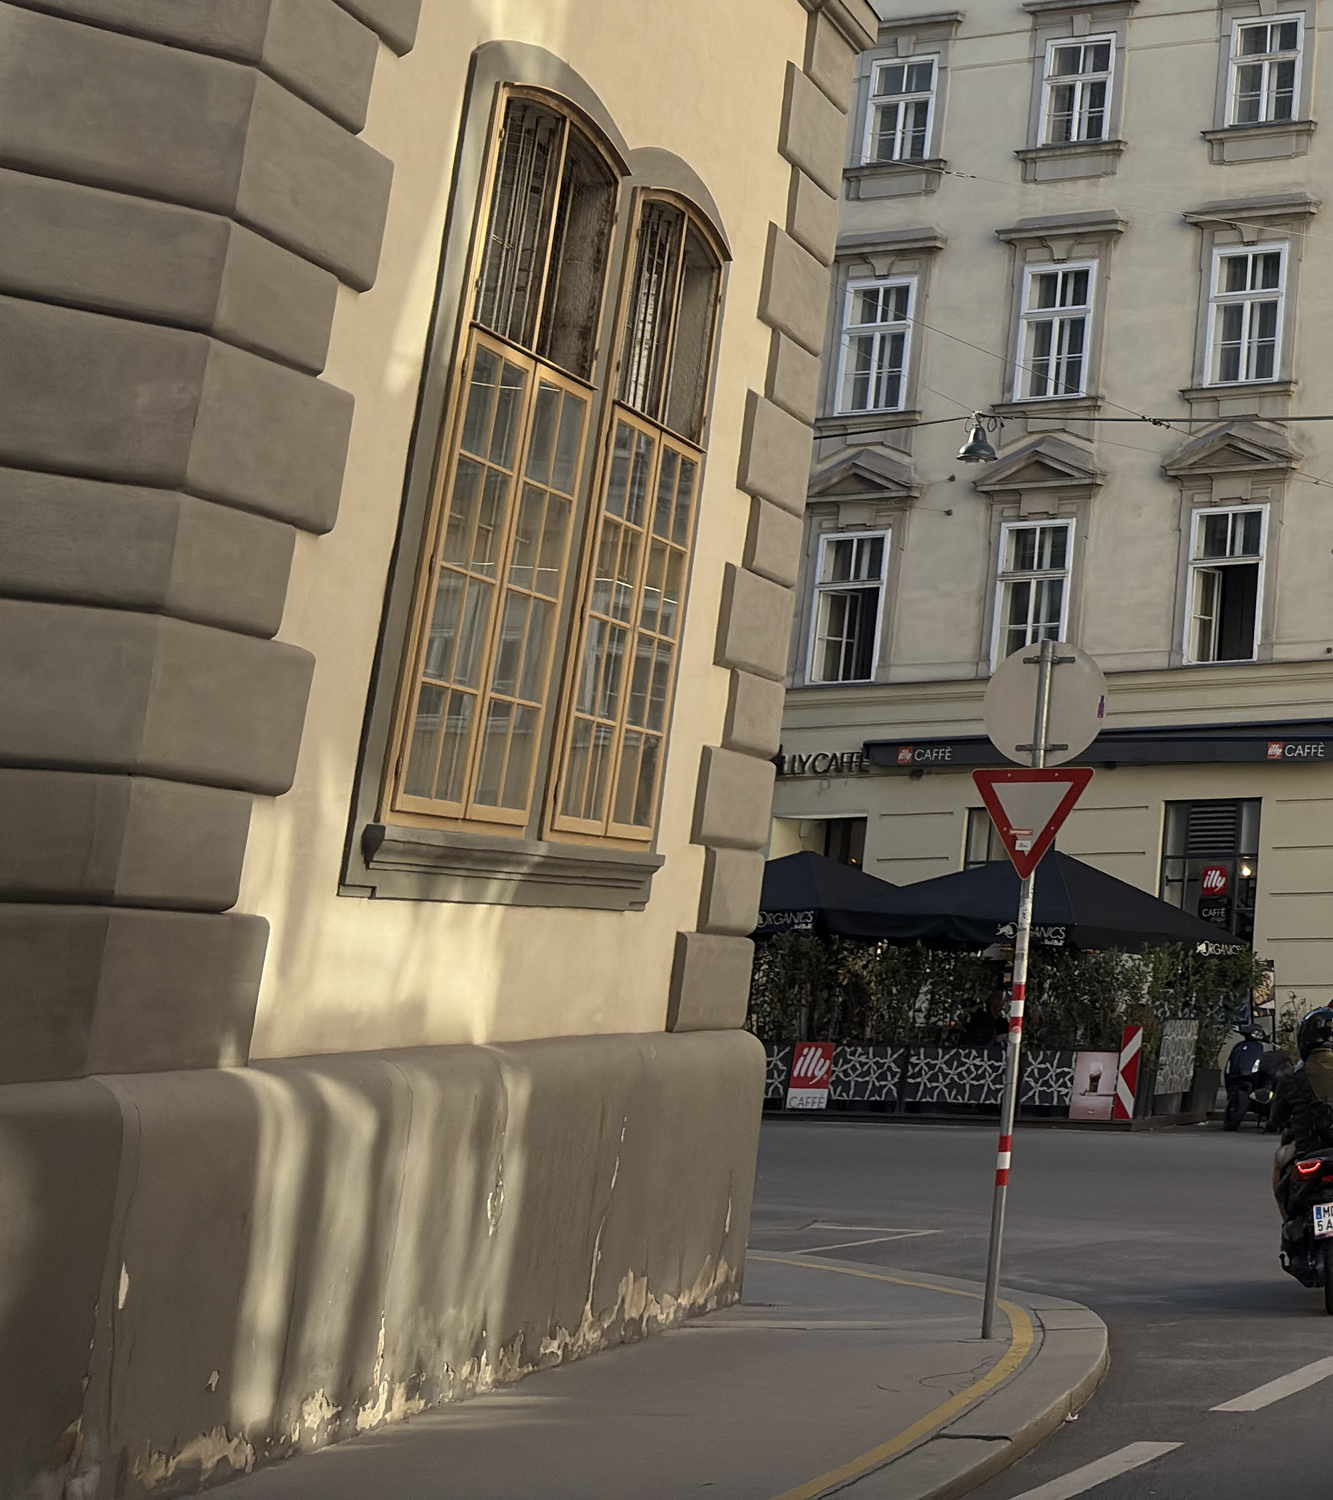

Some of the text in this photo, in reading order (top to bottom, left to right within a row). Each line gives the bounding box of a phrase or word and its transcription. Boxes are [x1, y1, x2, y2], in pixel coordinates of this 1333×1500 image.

[914, 746, 952, 761] CAFFÈ
[1285, 742, 1326, 757] CAFFÈ
[1203, 870, 1226, 892] illy
[793, 1046, 830, 1085] illy
[789, 1094, 825, 1109] CAFFÈ
